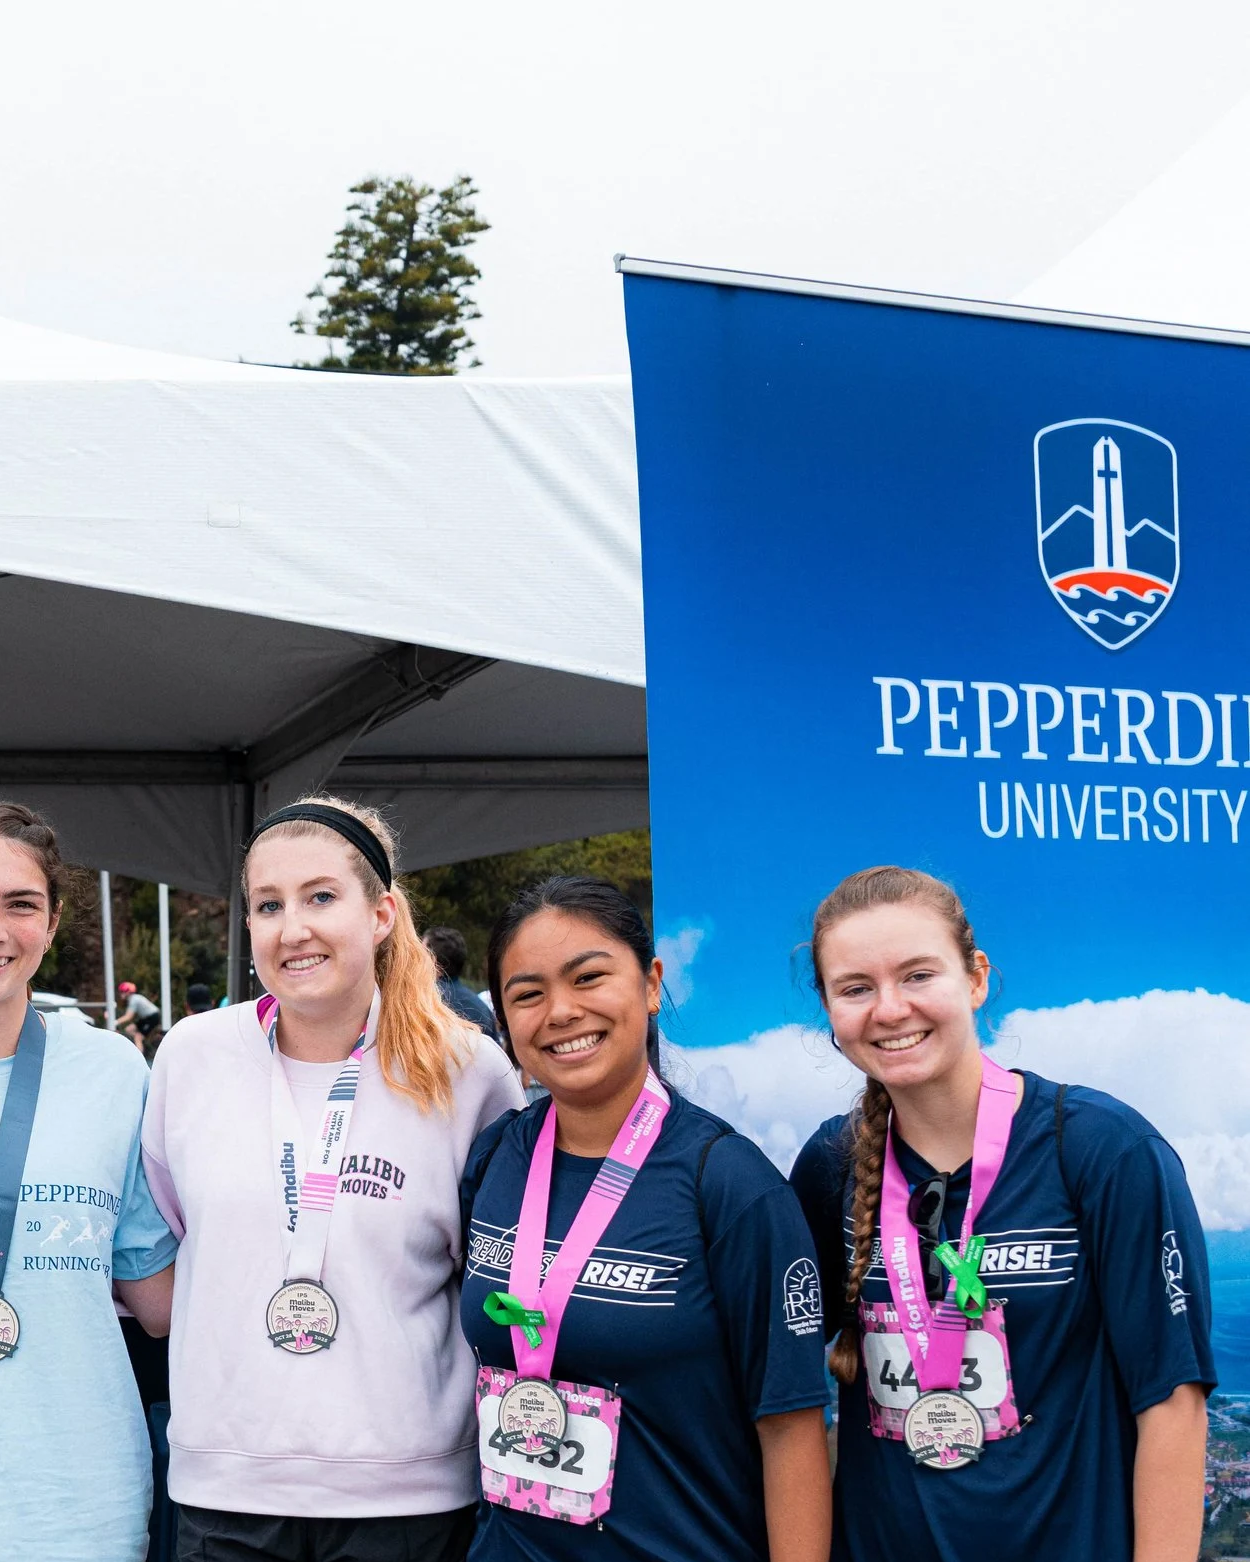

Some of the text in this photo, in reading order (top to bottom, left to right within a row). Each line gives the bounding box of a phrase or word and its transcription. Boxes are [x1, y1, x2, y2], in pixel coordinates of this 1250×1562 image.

[872, 676, 1250, 768] PEPPERDI
[978, 781, 1248, 843] UNIVERSITY
[20, 1184, 122, 1216] PEPPERDINE
[340, 1178, 388, 1200] MOVES
[26, 1221, 41, 1232] 20
[23, 1256, 100, 1272] RUNNING
[472, 1236, 515, 1267] READ
[582, 1260, 656, 1291] RISE!
[980, 1244, 1053, 1272] RISE!
[863, 1310, 877, 1322] IPS
[491, 1374, 506, 1387] IPS
[879, 1357, 983, 1393] 443
